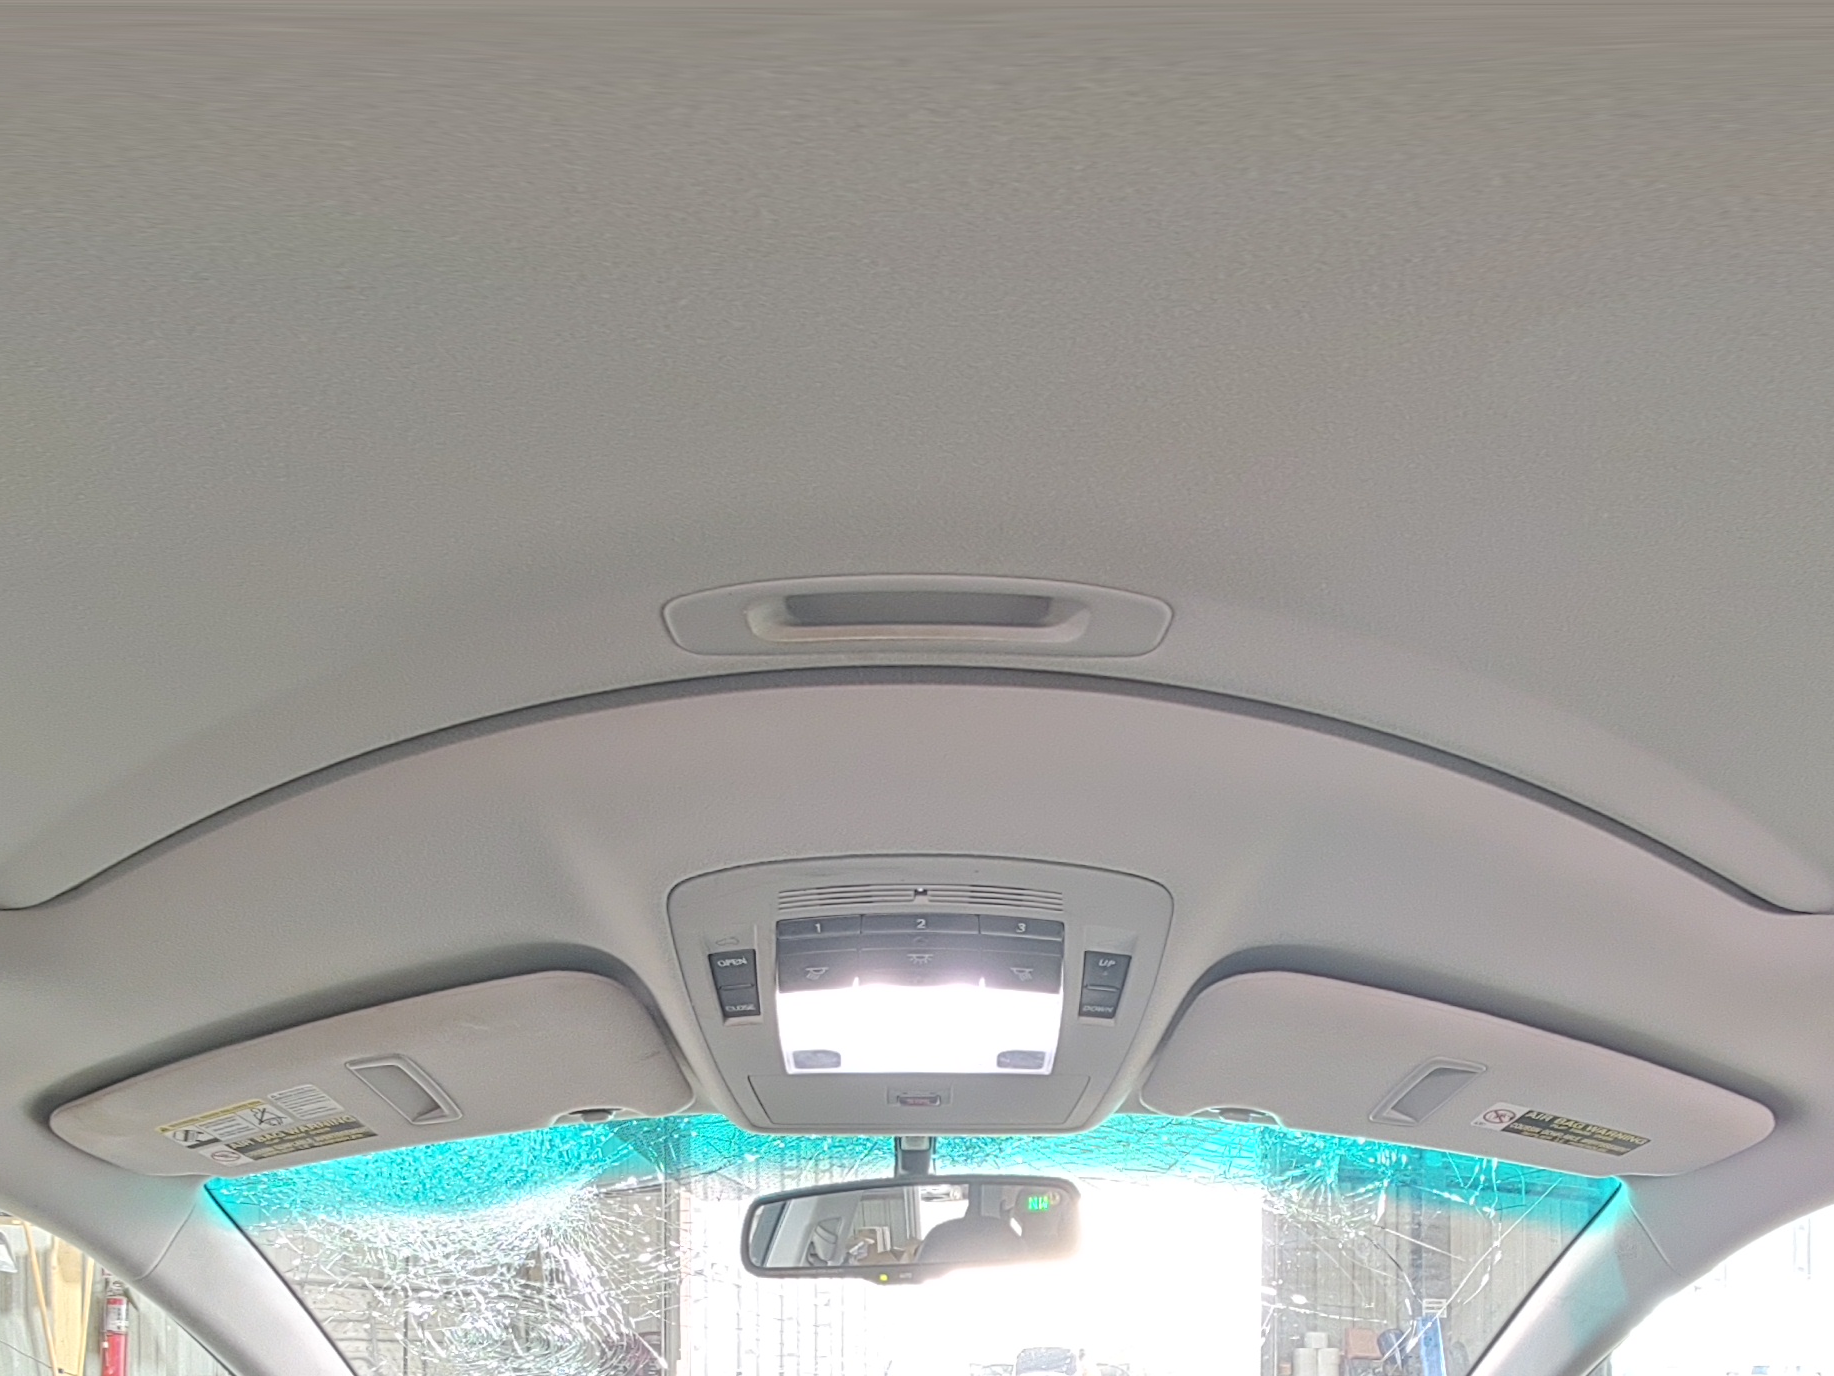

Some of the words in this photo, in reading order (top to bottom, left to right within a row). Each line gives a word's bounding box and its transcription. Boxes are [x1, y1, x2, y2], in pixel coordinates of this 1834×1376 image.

[815, 923, 821, 933] 1
[917, 918, 926, 929] 2
[1016, 922, 1026, 933] 3
[717, 956, 748, 968] OPEN
[1098, 958, 1116, 968] UP
[725, 1003, 756, 1012] CLOSE
[1082, 1004, 1114, 1013] DOWN
[229, 1138, 255, 1150] AIR
[257, 1131, 285, 1143] BAG
[286, 1115, 357, 1135] WARNING
[1525, 1111, 1553, 1122] AIR
[1554, 1116, 1585, 1130] BAG
[1586, 1124, 1647, 1144] WARNING
[1028, 1196, 1048, 1210] NW
